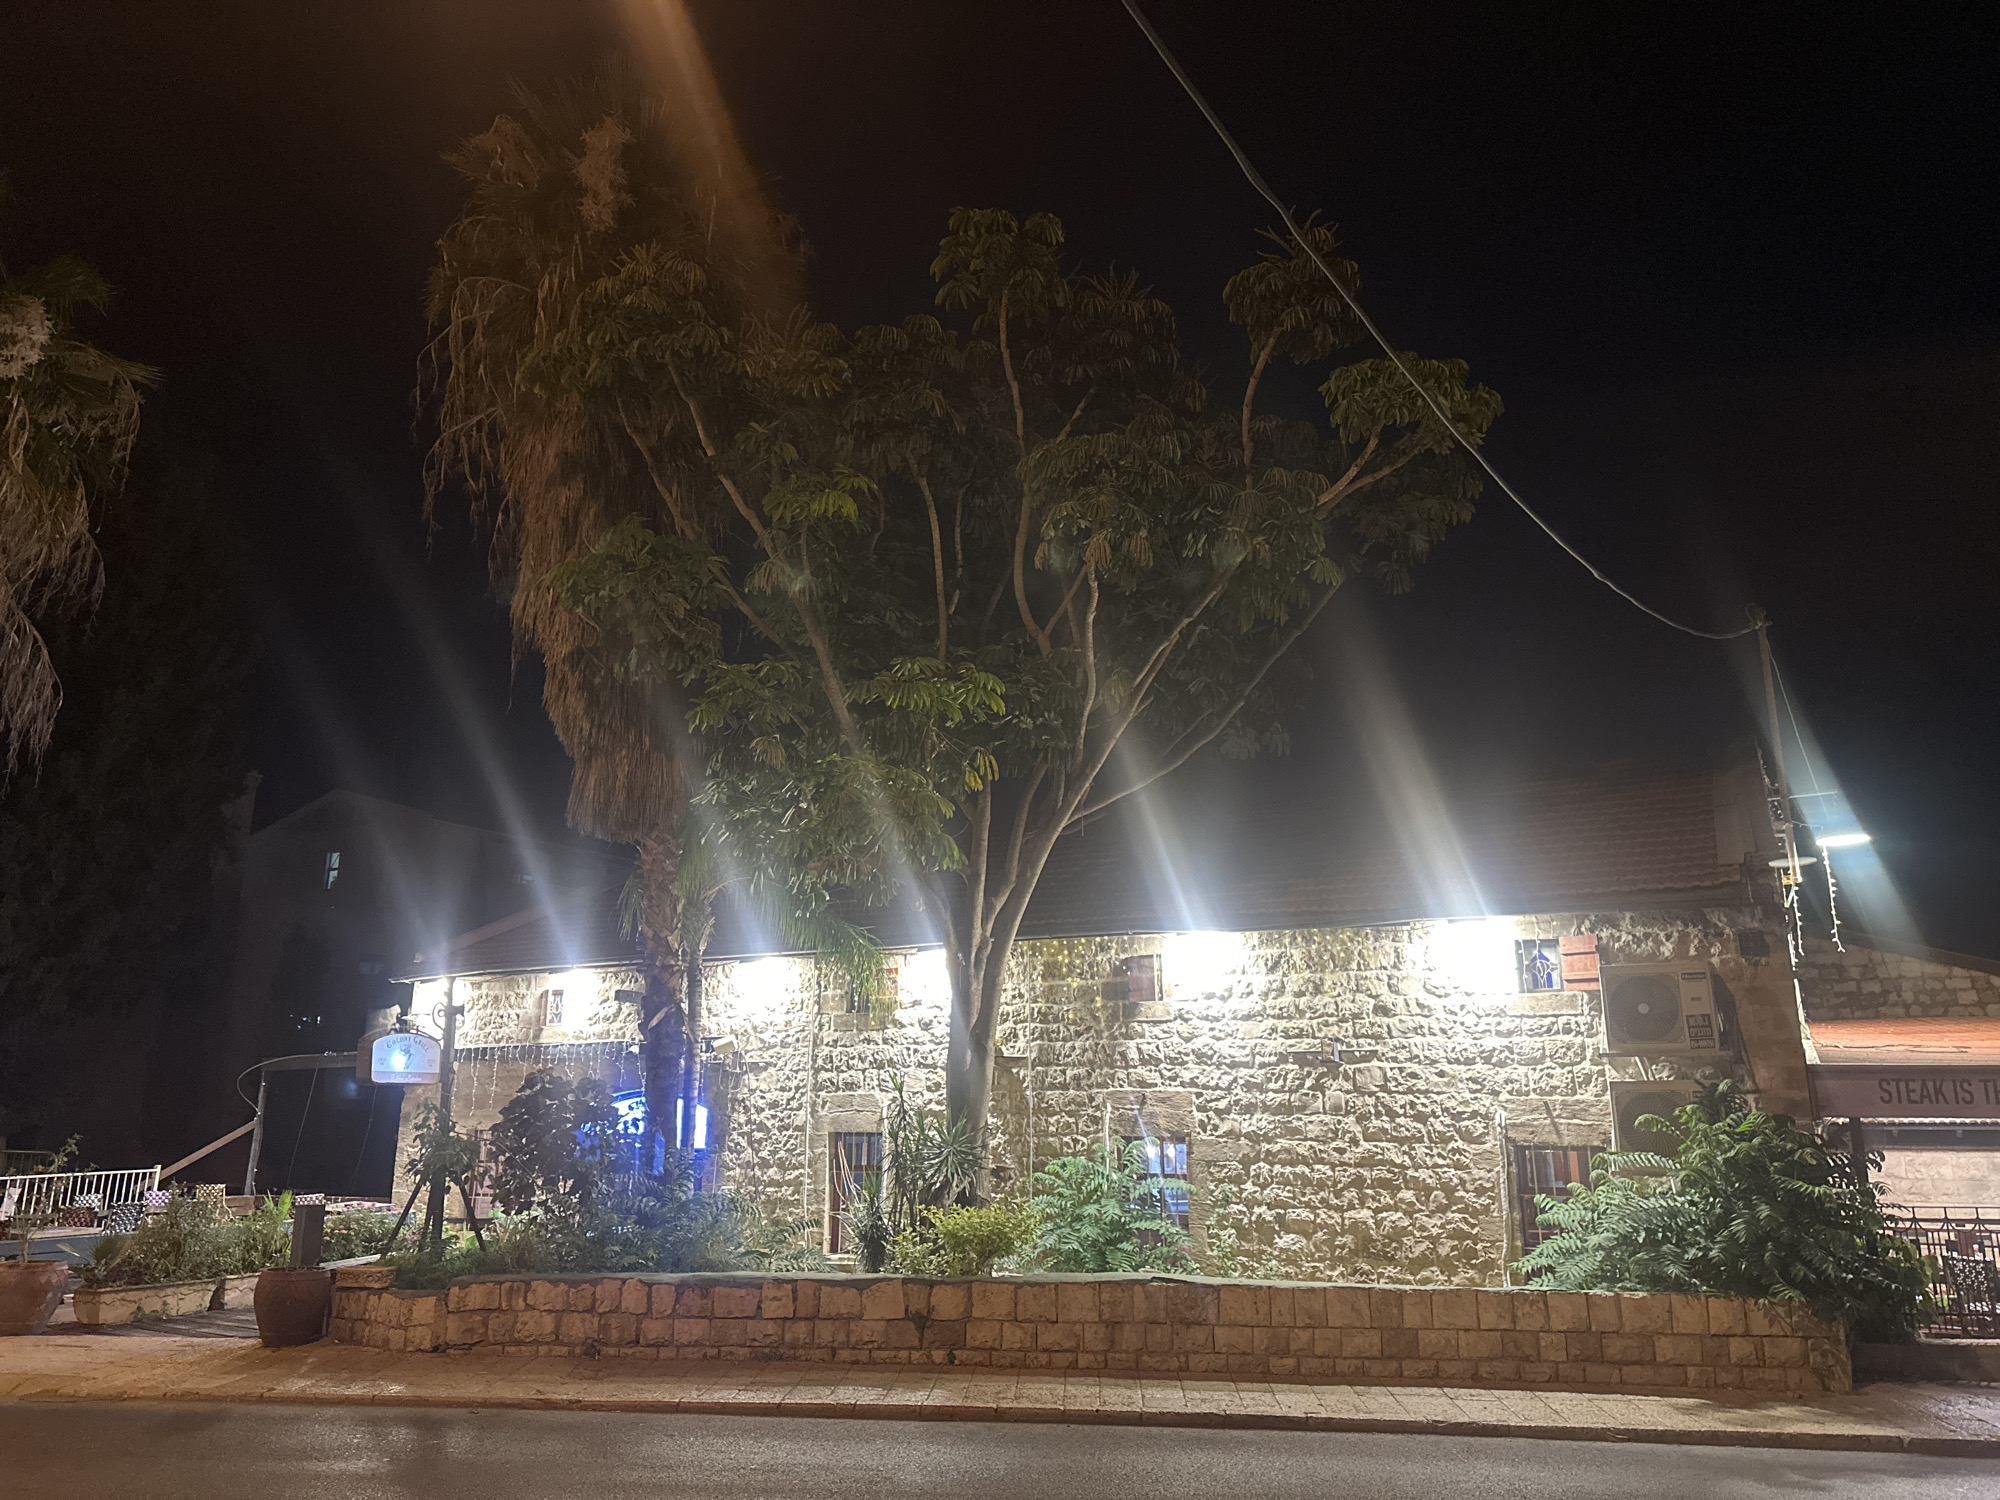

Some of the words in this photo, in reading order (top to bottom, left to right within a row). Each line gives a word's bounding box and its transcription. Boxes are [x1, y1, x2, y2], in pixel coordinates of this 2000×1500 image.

[413, 1036, 429, 1053] GRILL
[1878, 1078, 1949, 1105] STEAK
[1952, 1078, 1975, 1105] IS
